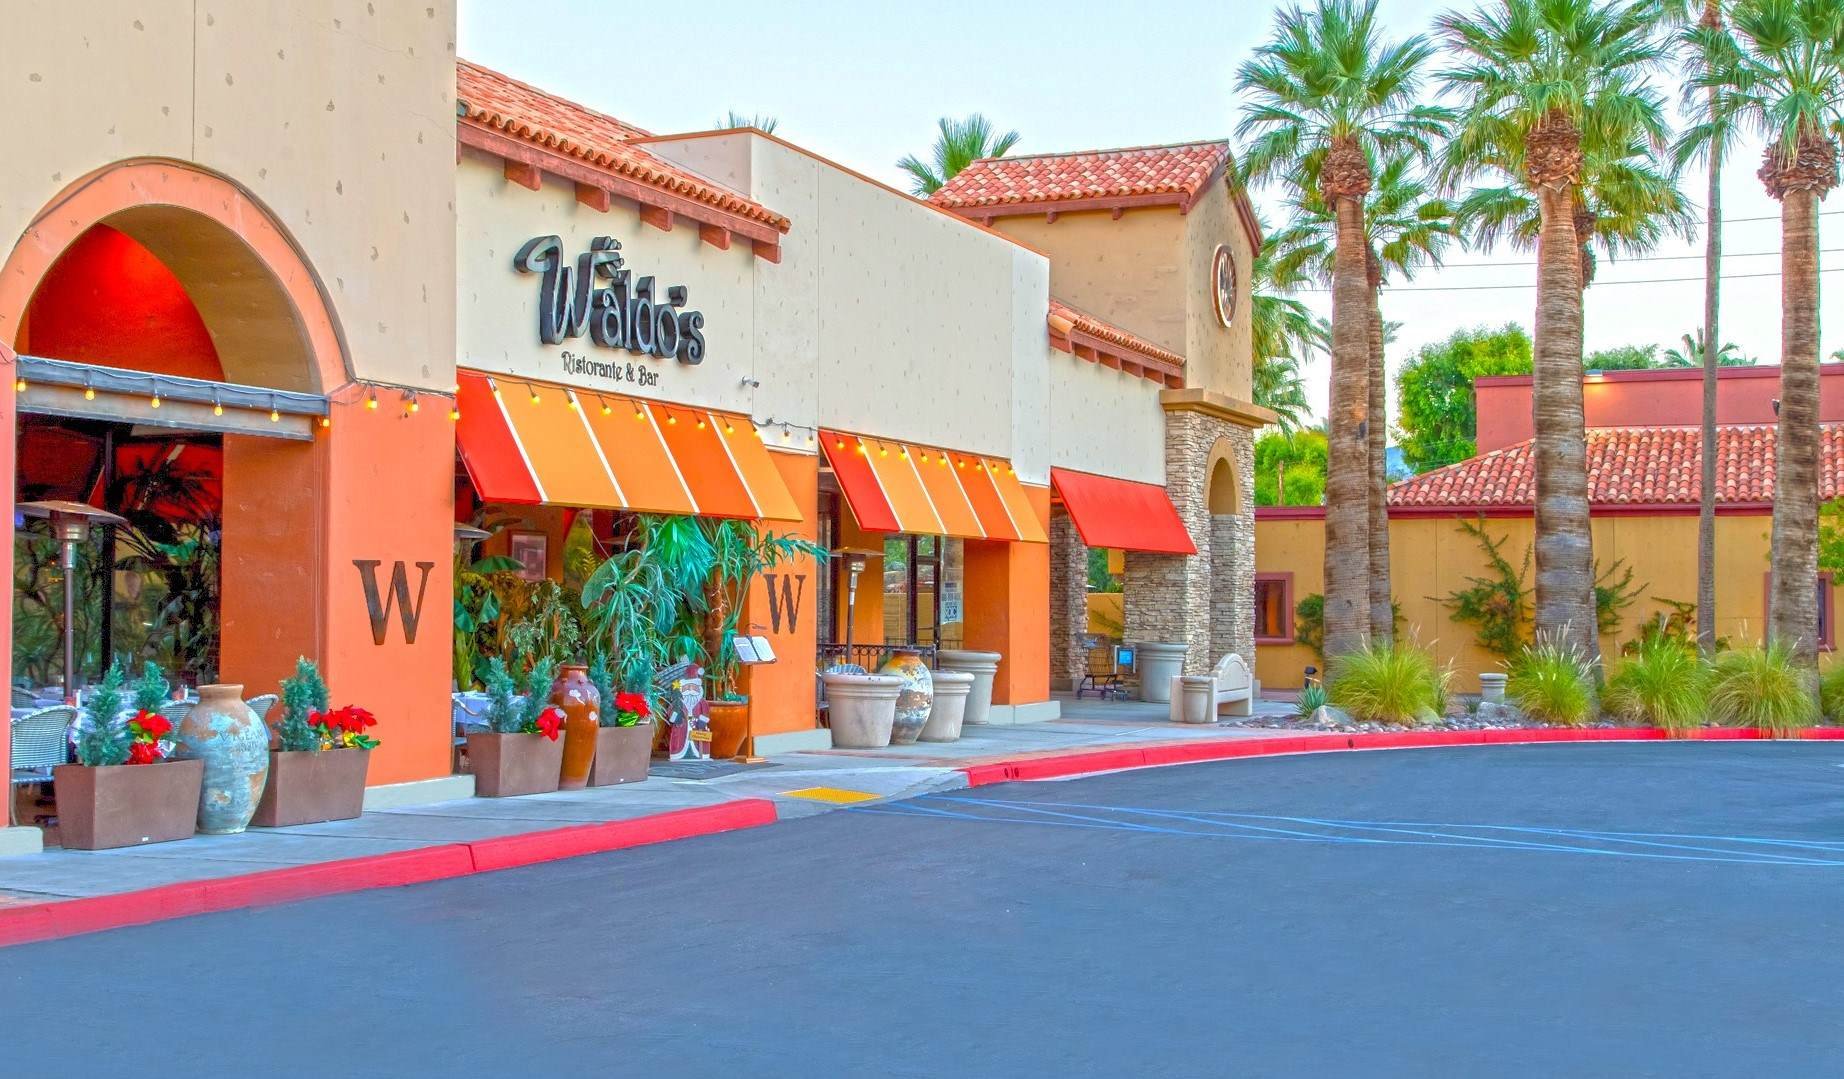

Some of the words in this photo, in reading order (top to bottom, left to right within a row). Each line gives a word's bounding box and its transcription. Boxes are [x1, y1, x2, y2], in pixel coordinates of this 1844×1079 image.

[514, 235, 705, 365] Waldo's
[561, 351, 622, 382] Ristorante
[626, 362, 635, 382] &
[638, 365, 659, 386] Bar
[352, 559, 434, 646] W
[763, 574, 806, 634] W
